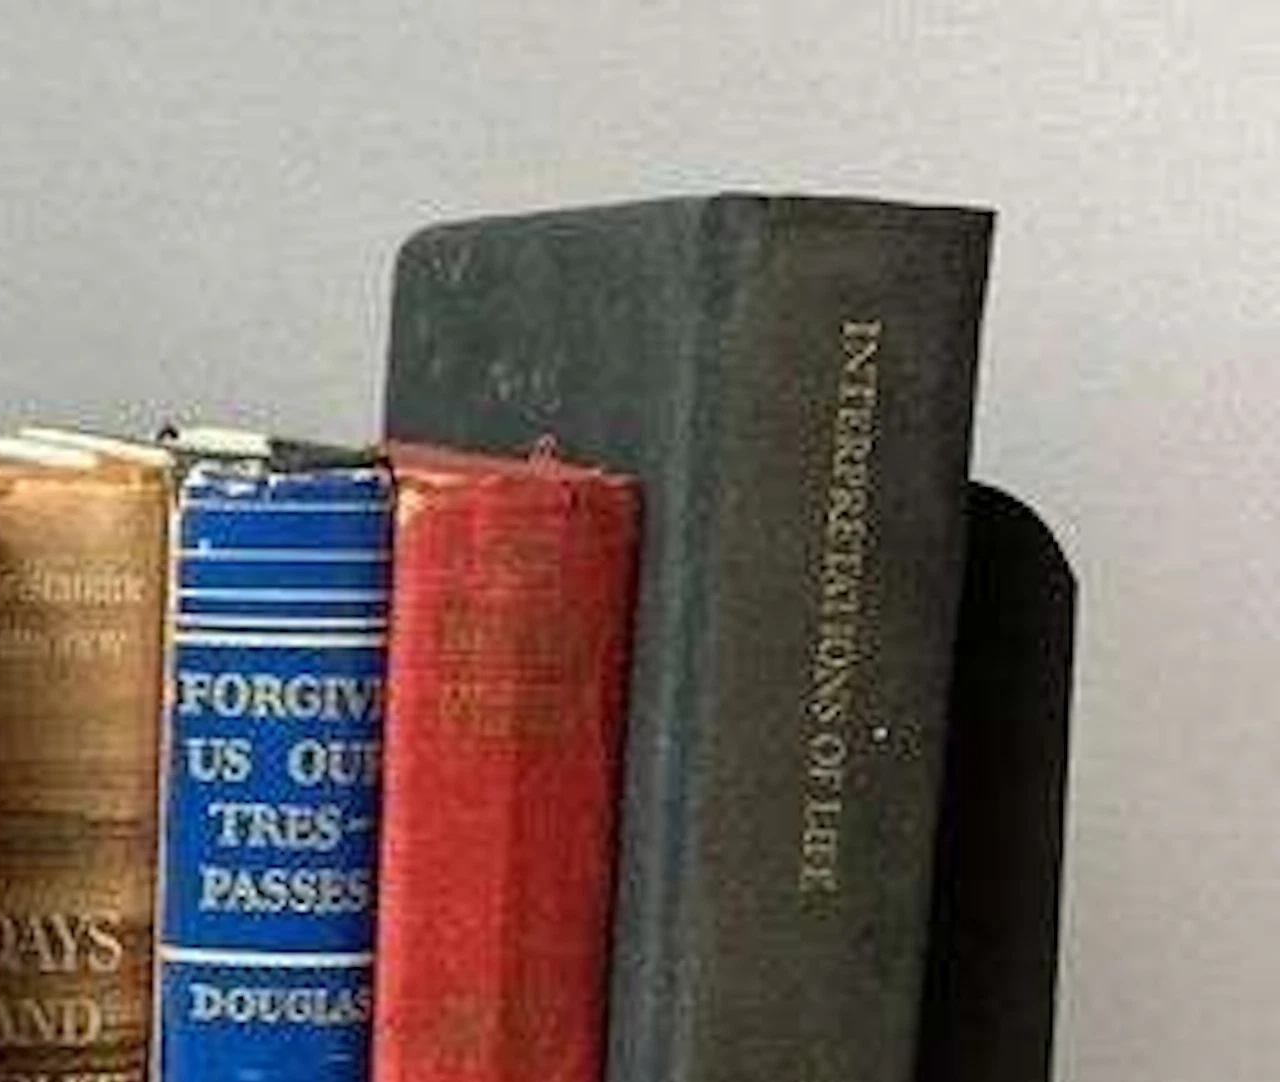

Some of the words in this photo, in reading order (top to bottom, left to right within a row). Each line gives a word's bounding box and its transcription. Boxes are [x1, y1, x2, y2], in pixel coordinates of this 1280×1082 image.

[809, 318, 883, 723] INTERPRETATIONS
[184, 736, 253, 784] US
[805, 731, 849, 796] OF
[208, 801, 371, 851] TRES-
[798, 799, 842, 902] LIFE
[198, 864, 372, 913] PASSES
[188, 982, 372, 1025] DOUGLAS
